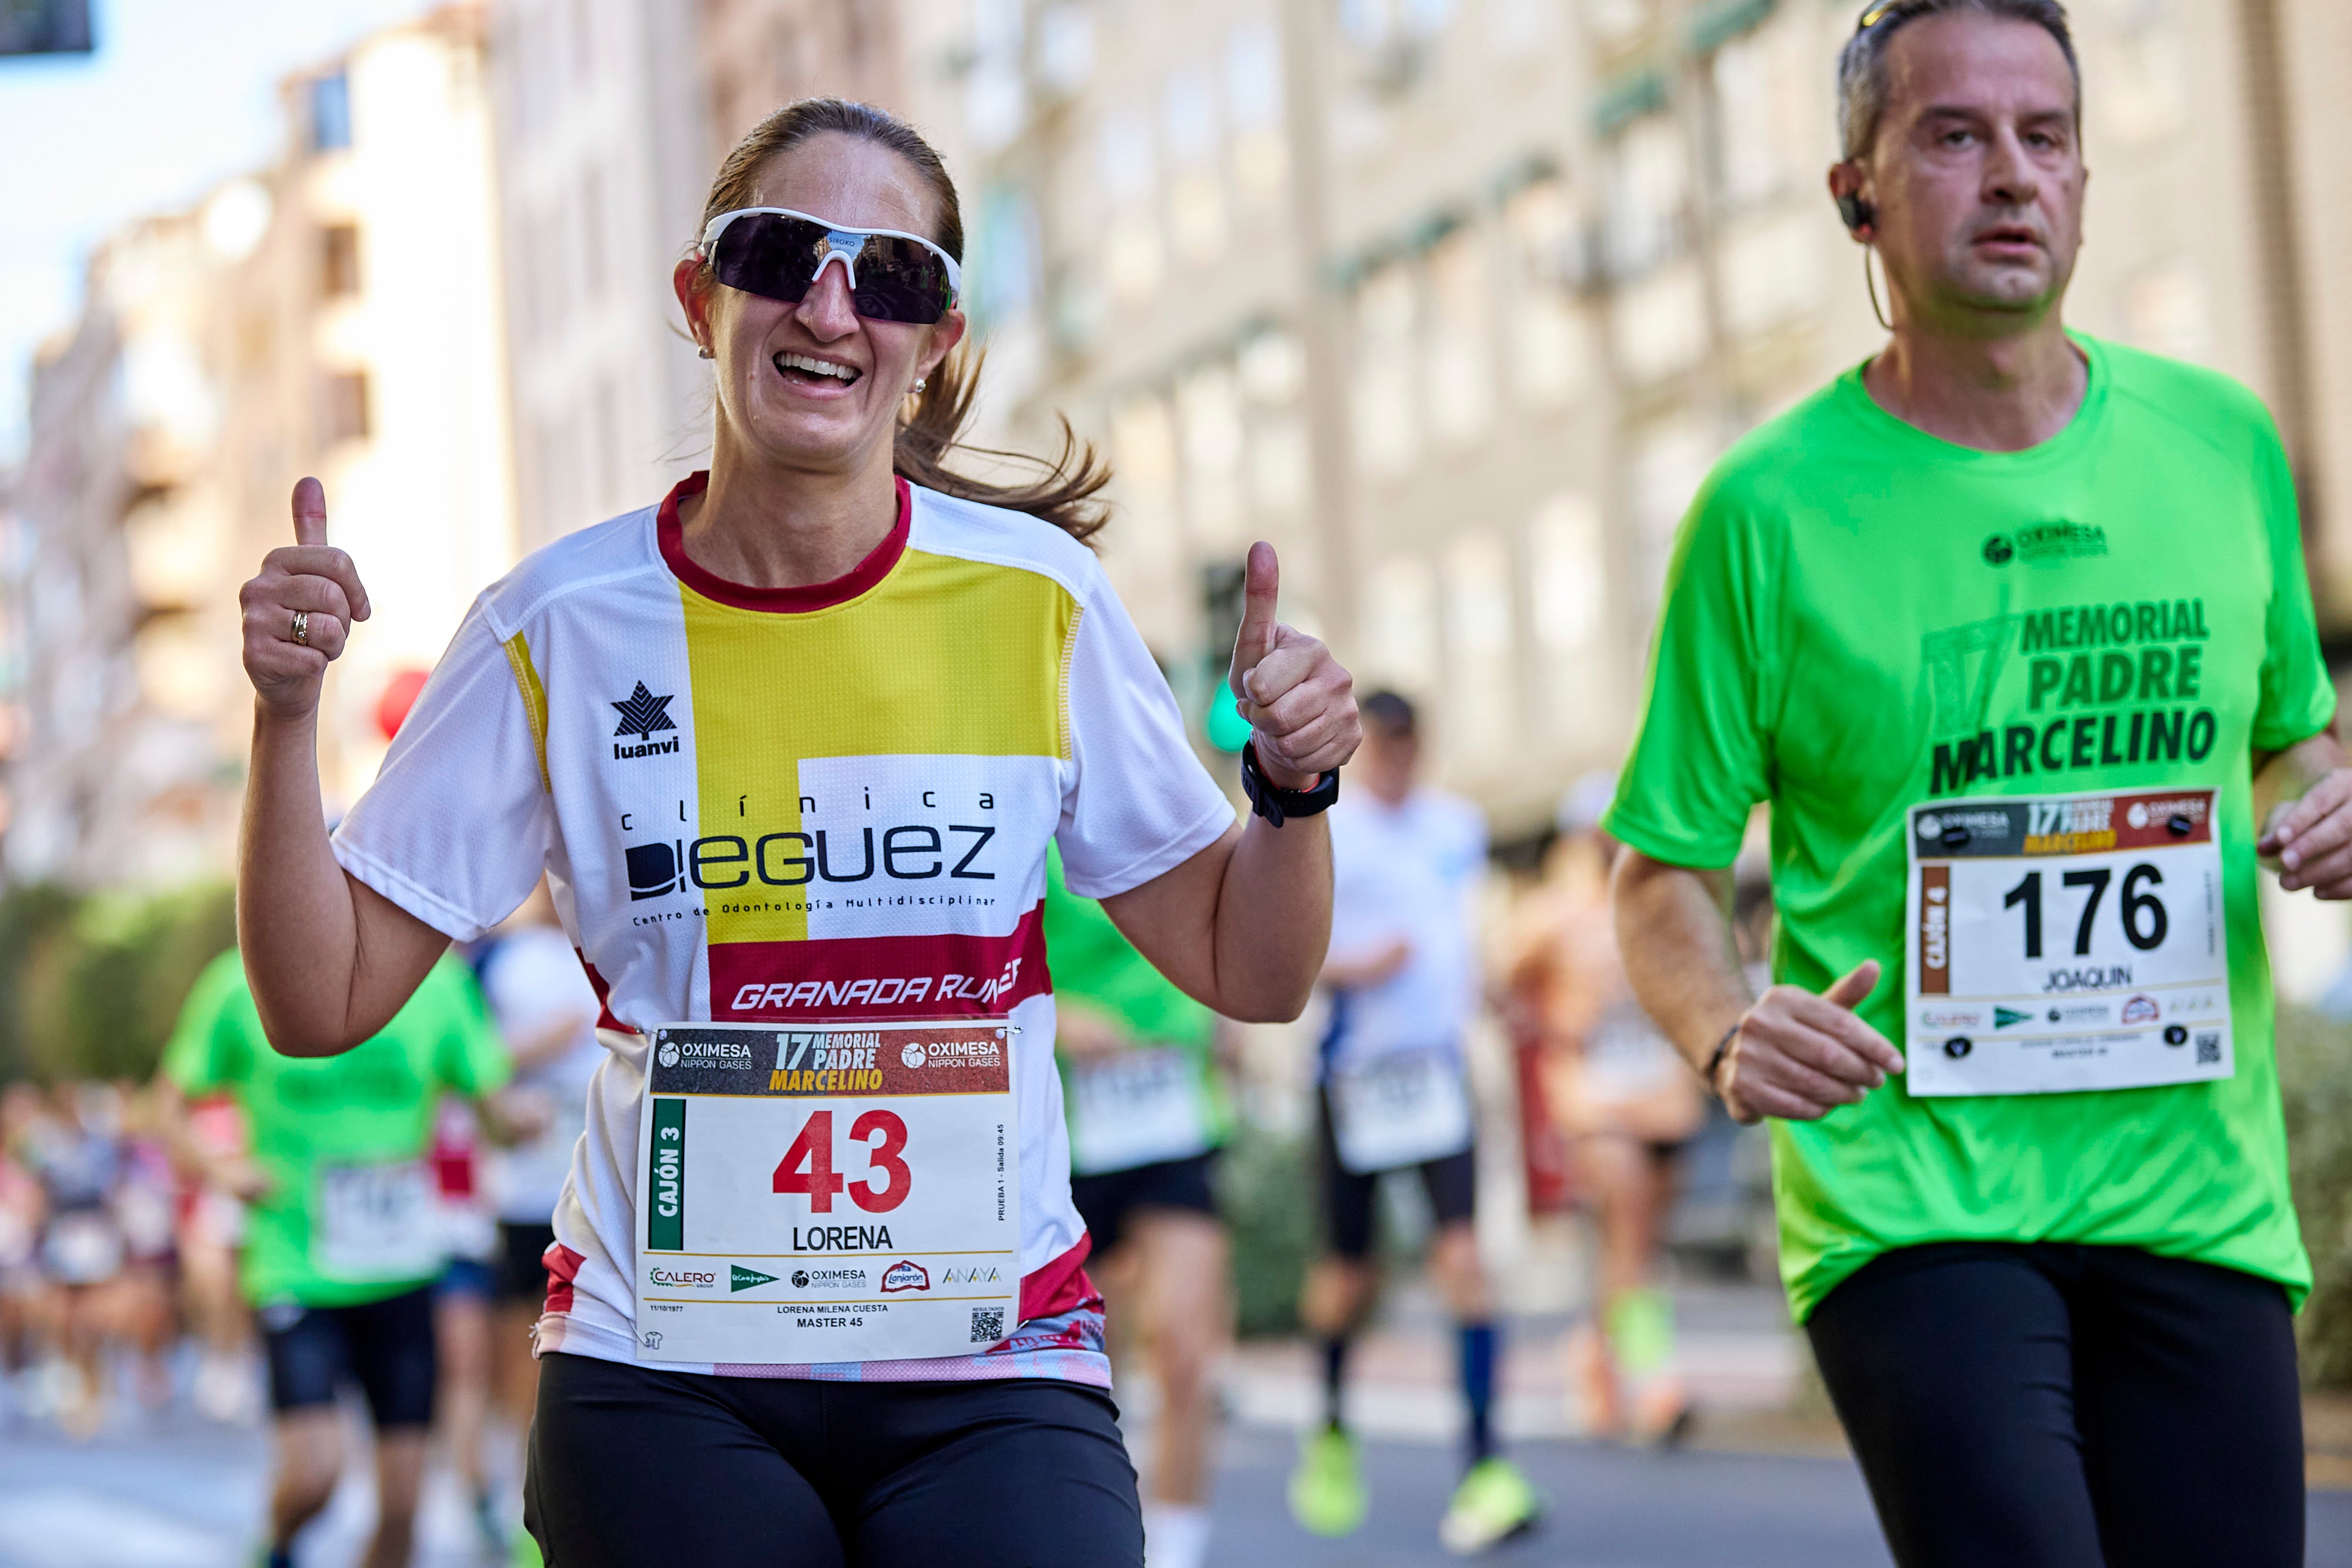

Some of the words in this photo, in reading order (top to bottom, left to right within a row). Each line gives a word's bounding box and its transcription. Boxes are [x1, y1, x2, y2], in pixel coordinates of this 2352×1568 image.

[829, 237, 855, 247] SIROKO
[2020, 599, 2209, 651] MEMORIAL
[2029, 648, 2201, 709] PADRE
[614, 736, 679, 760] luanvi
[1930, 710, 2216, 794] MARCELINO
[633, 912, 682, 926] Centro
[694, 908, 710, 916] de
[723, 899, 833, 913] Odontología
[846, 895, 995, 907] Multidisciplinar
[2004, 864, 2169, 959] 176
[2043, 967, 2132, 991] JOAQUIN
[731, 977, 933, 1011] GRANADA
[682, 1042, 752, 1058] OXIMESA
[776, 1033, 814, 1070] 17
[813, 1032, 881, 1049] MEMORIAL
[928, 1041, 1000, 1057] OXIMESA
[681, 1059, 716, 1069] NIPPON
[720, 1059, 752, 1070] GASES
[813, 1048, 877, 1070] PADRE
[928, 1059, 965, 1068] NIPPON
[968, 1058, 1000, 1067] GASES
[769, 1069, 883, 1091] MARCELINO
[660, 1127, 680, 1141] 3
[772, 1109, 911, 1214] 43
[654, 1149, 679, 1217] CAJÓN
[793, 1225, 893, 1251] LORENA
[654, 1271, 715, 1283] CALERO
[812, 1269, 866, 1280] OXIMESA
[888, 1273, 923, 1283] Lanjarón
[943, 1267, 1001, 1283] ANAYA
[797, 1318, 847, 1328] MASTER
[850, 1318, 863, 1327] 45
